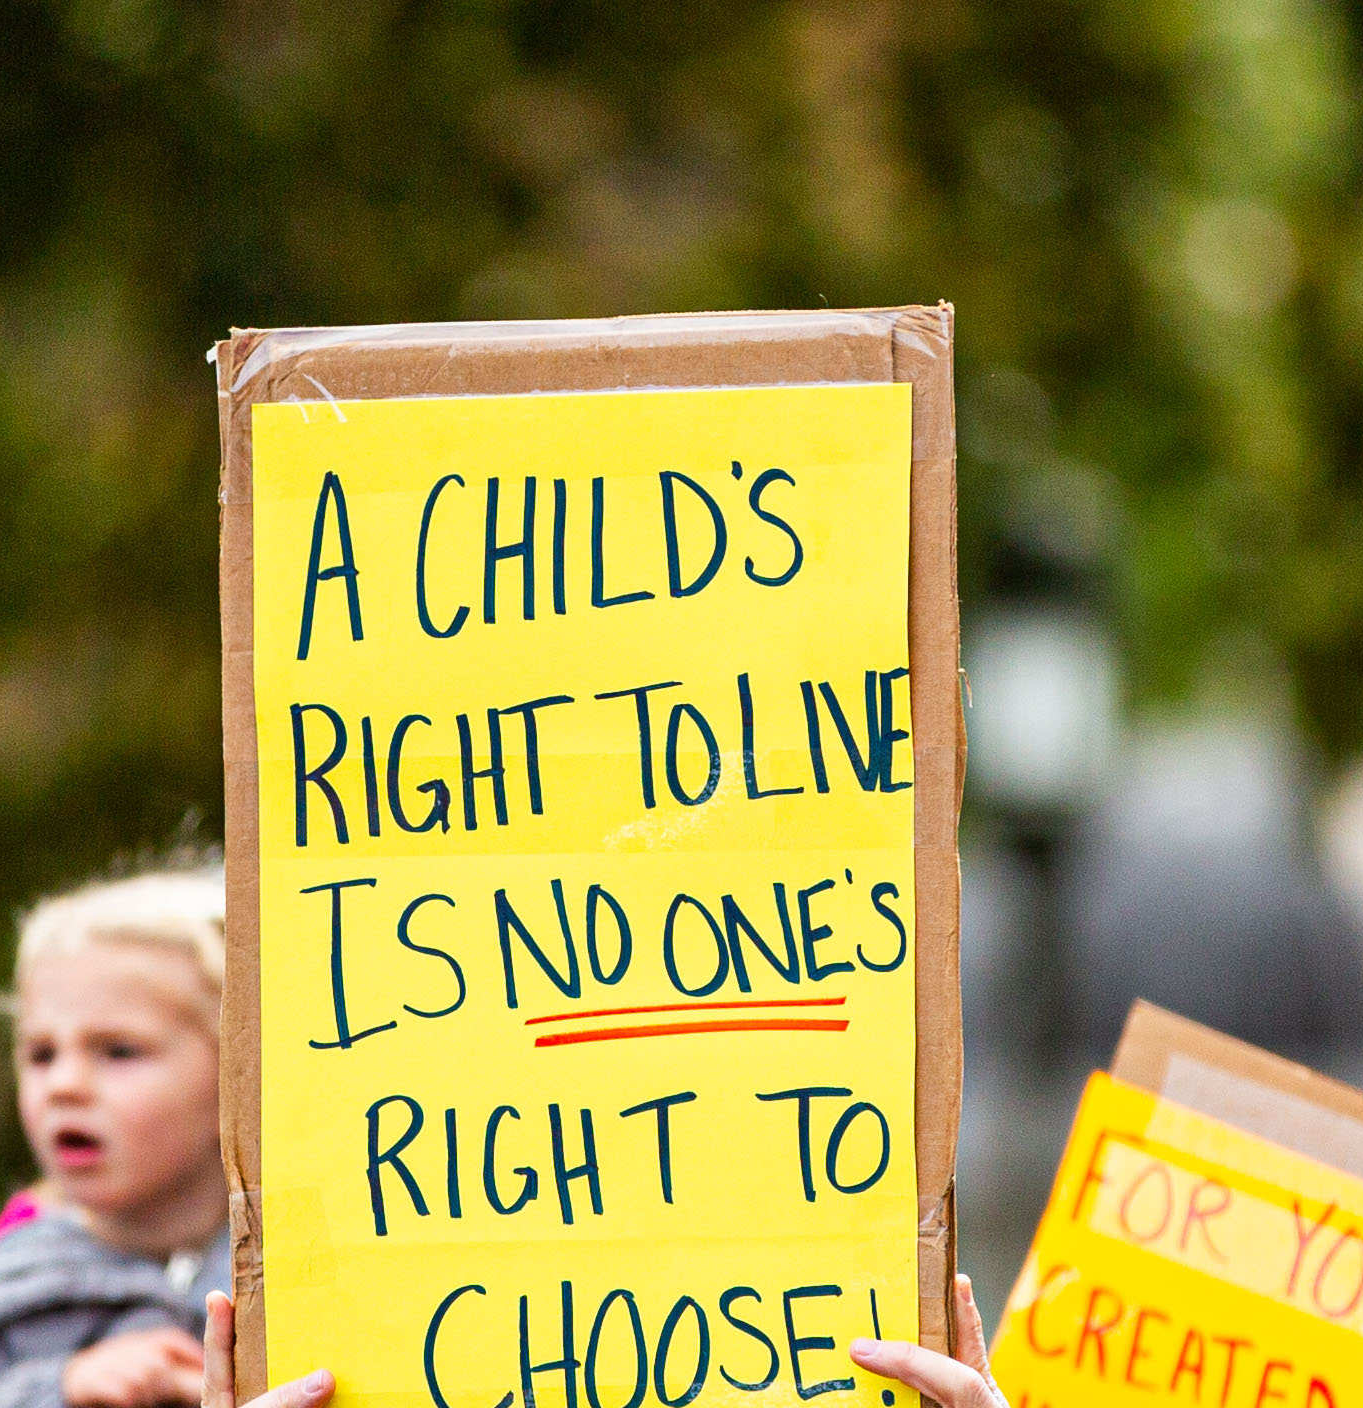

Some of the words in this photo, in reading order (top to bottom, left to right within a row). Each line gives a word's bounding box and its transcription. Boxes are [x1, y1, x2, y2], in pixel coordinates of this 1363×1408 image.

[297, 471, 364, 660] A
[416, 461, 803, 639] CHILD'S
[291, 695, 575, 848] RIGHT
[595, 681, 721, 809] TO
[738, 667, 913, 800] LIVE
[300, 878, 467, 1049] IS
[496, 879, 632, 1009] NO
[664, 869, 908, 996] ONE'S
[366, 1091, 697, 1236] RIGHT
[756, 1087, 891, 1202] TO
[1067, 1130, 1234, 1265] FOR
